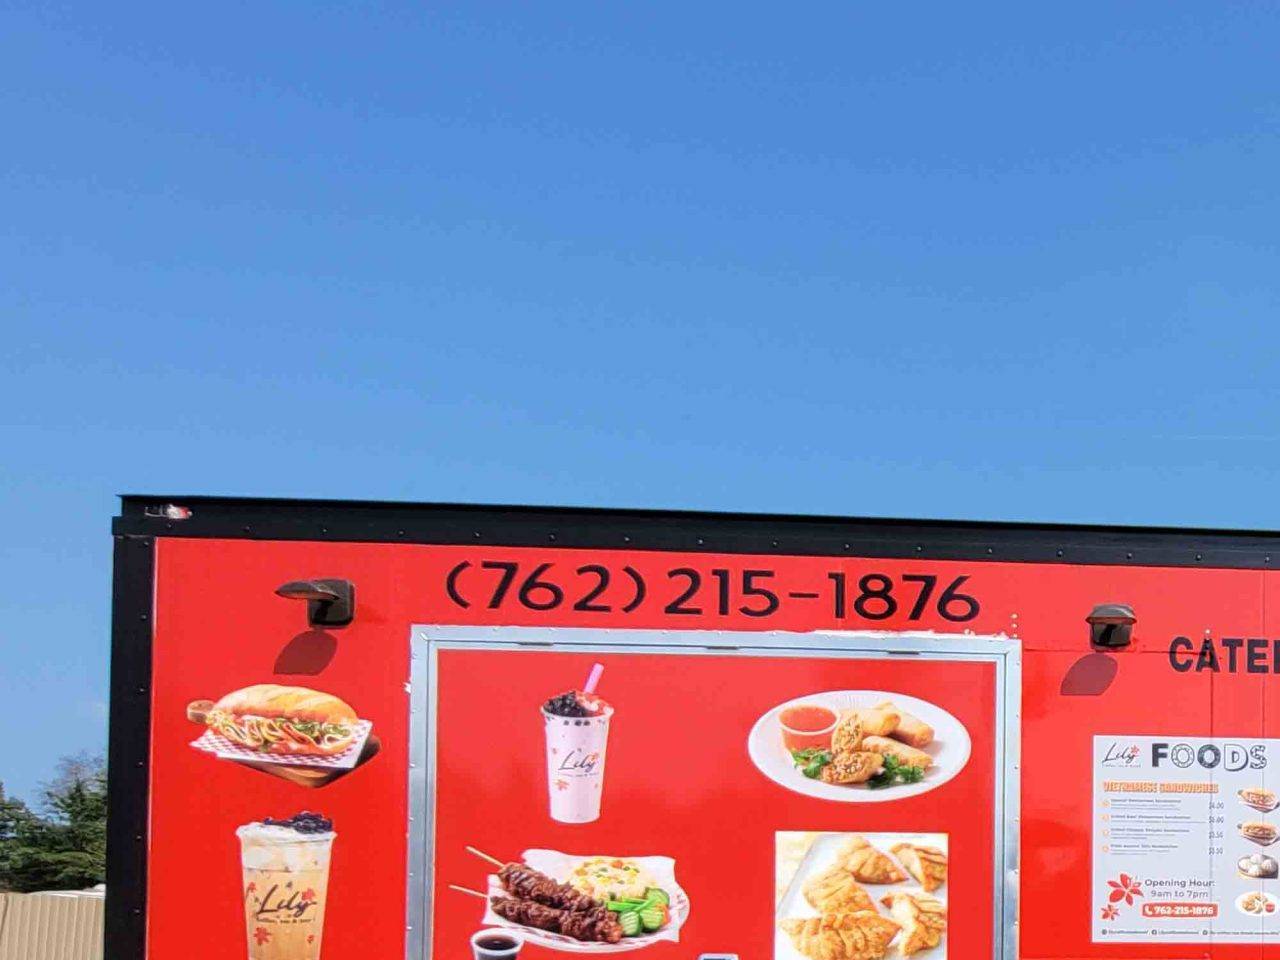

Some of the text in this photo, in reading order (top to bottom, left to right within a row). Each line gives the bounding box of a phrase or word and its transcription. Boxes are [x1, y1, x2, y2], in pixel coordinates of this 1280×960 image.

[1102, 742, 1137, 763] Lily
[1151, 743, 1268, 772] FOODS
[1144, 878, 1186, 889] Opening
[256, 884, 317, 918] Lily
[1150, 889, 1209, 899] 9am to 7pm
[1154, 906, 1215, 915] 762-215-1876
